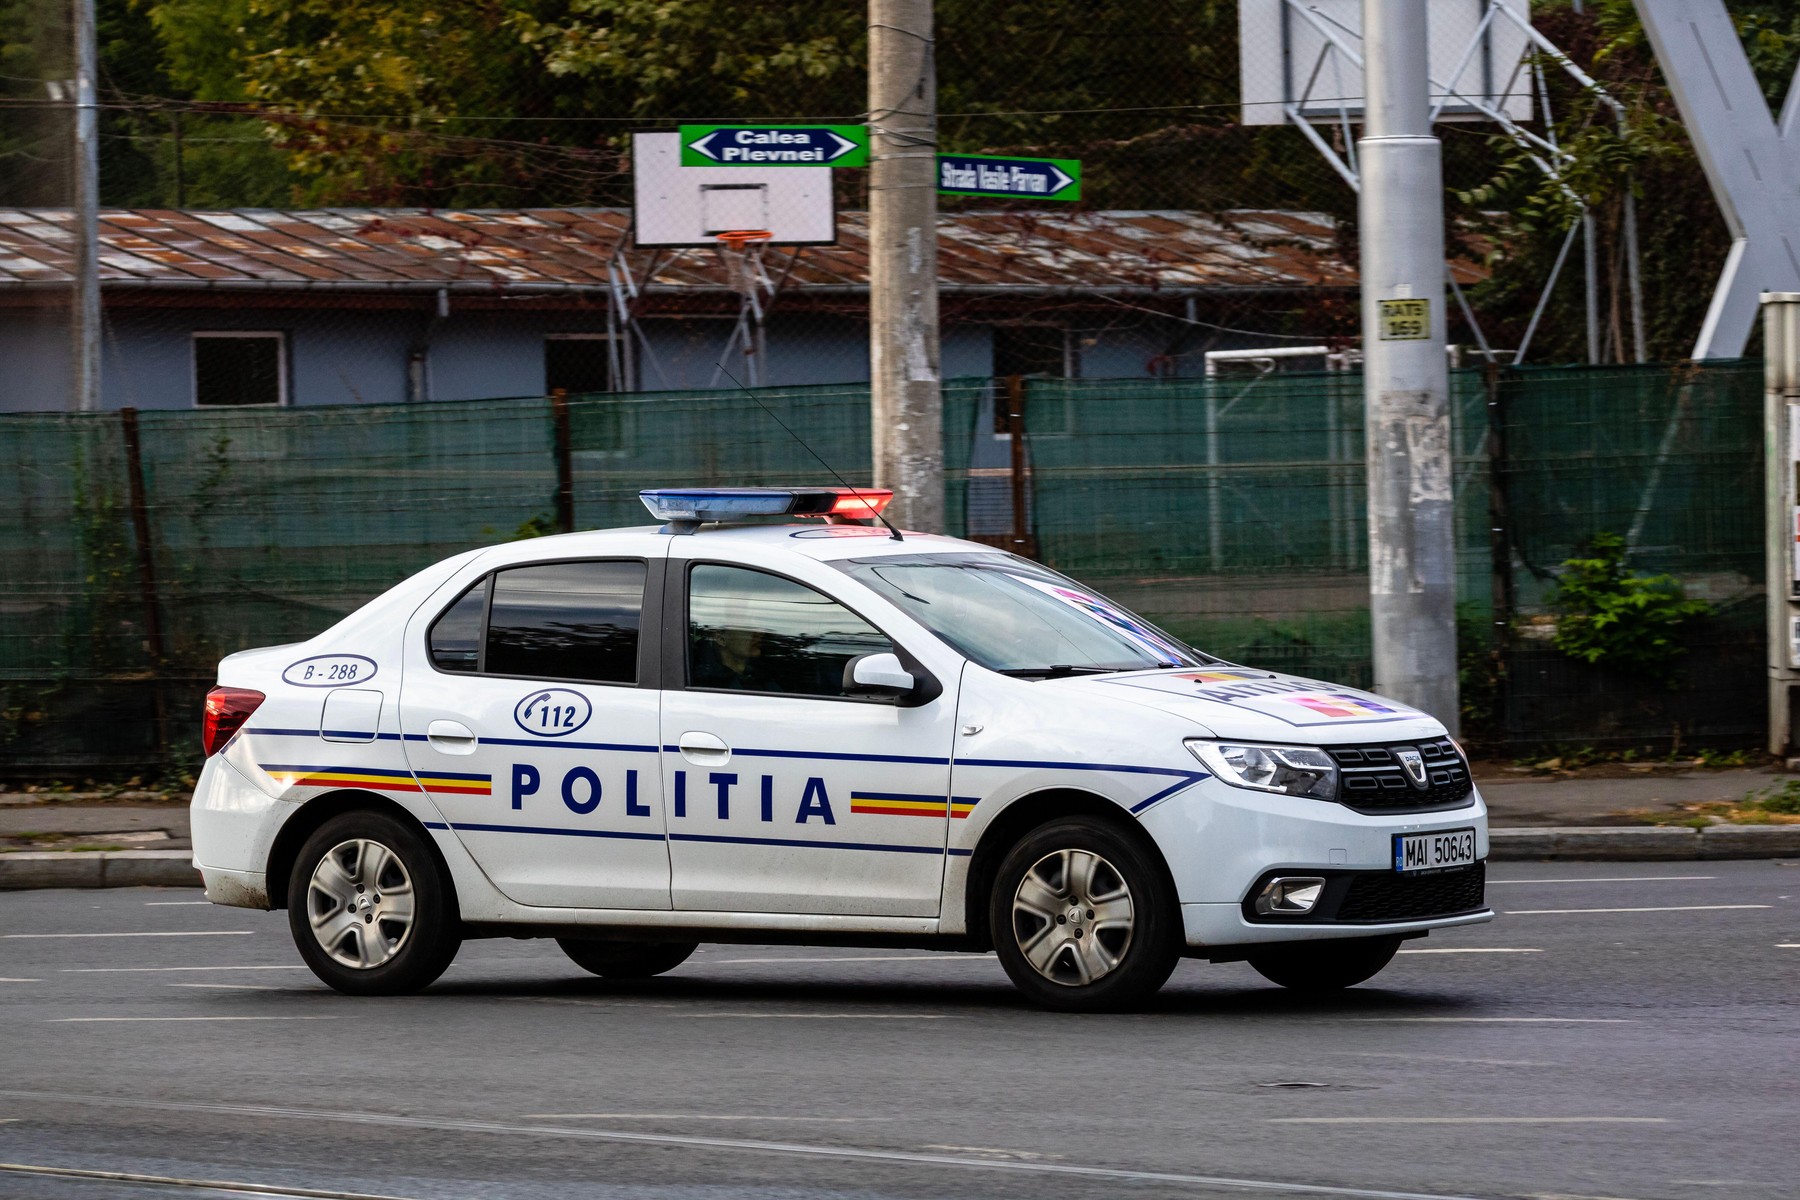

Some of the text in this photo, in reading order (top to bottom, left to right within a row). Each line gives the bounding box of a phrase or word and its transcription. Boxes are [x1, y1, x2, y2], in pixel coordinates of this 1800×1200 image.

[735, 131, 811, 145] Calea
[722, 147, 824, 161] Plevnei
[941, 161, 978, 189] Strada
[977, 164, 1010, 191] Vasile
[1388, 320, 1422, 336] 169
[303, 665, 314, 680] B
[328, 663, 358, 680] 288
[540, 705, 575, 728] 112
[511, 763, 836, 826] POLITIA
[1405, 834, 1472, 867] MAI 50643
[1396, 856, 1403, 868] RO
